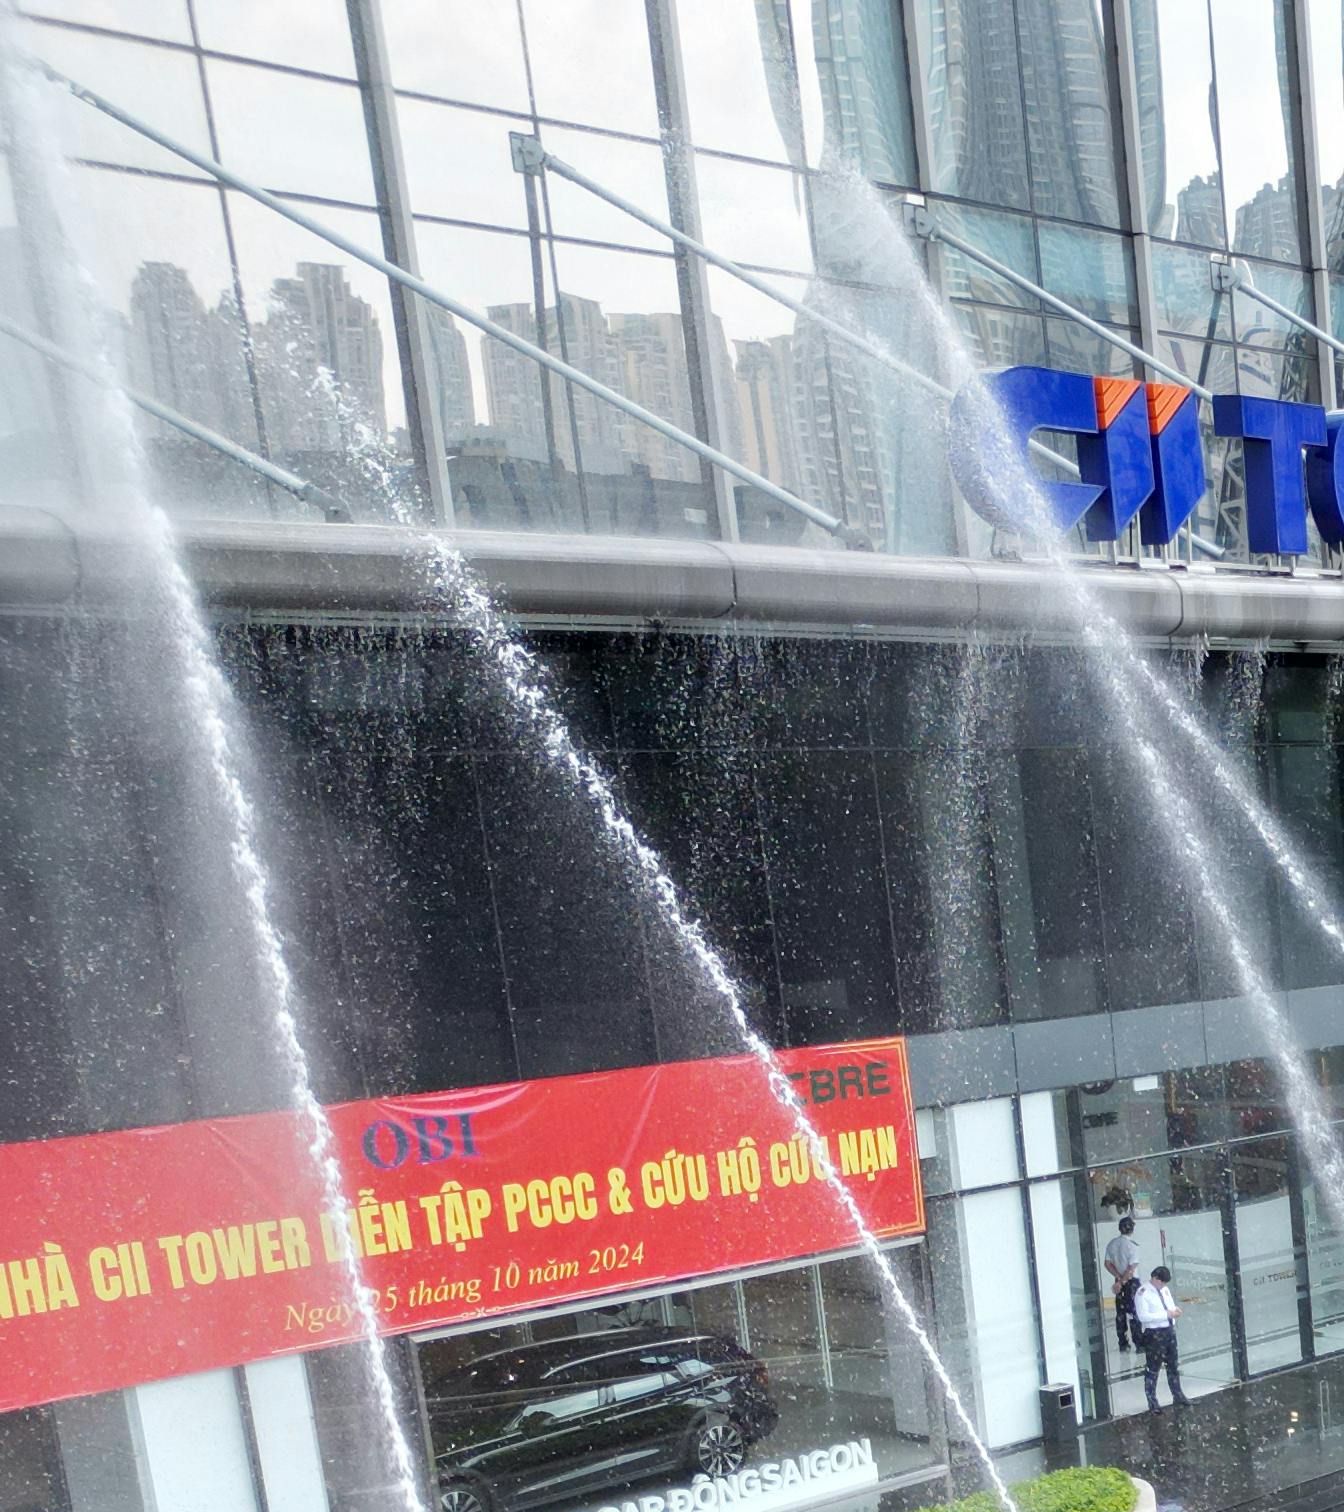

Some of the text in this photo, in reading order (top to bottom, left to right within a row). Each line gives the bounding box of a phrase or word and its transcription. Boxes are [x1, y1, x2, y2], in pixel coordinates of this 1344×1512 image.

[362, 1112, 480, 1169] OBI
[158, 1216, 311, 1290] TOWER
[419, 1181, 492, 1252] TẬP
[502, 1172, 599, 1233] PCCC
[607, 1167, 633, 1214] &
[641, 1149, 709, 1209] CỨU
[717, 1136, 761, 1202] HỘ
[838, 1125, 898, 1181] NẠN
[408, 1276, 482, 1308] tháng
[493, 1263, 520, 1292] 10
[528, 1258, 580, 1284] năm
[588, 1242, 645, 1274] 2024
[760, 1438, 873, 1491] SAIGON
